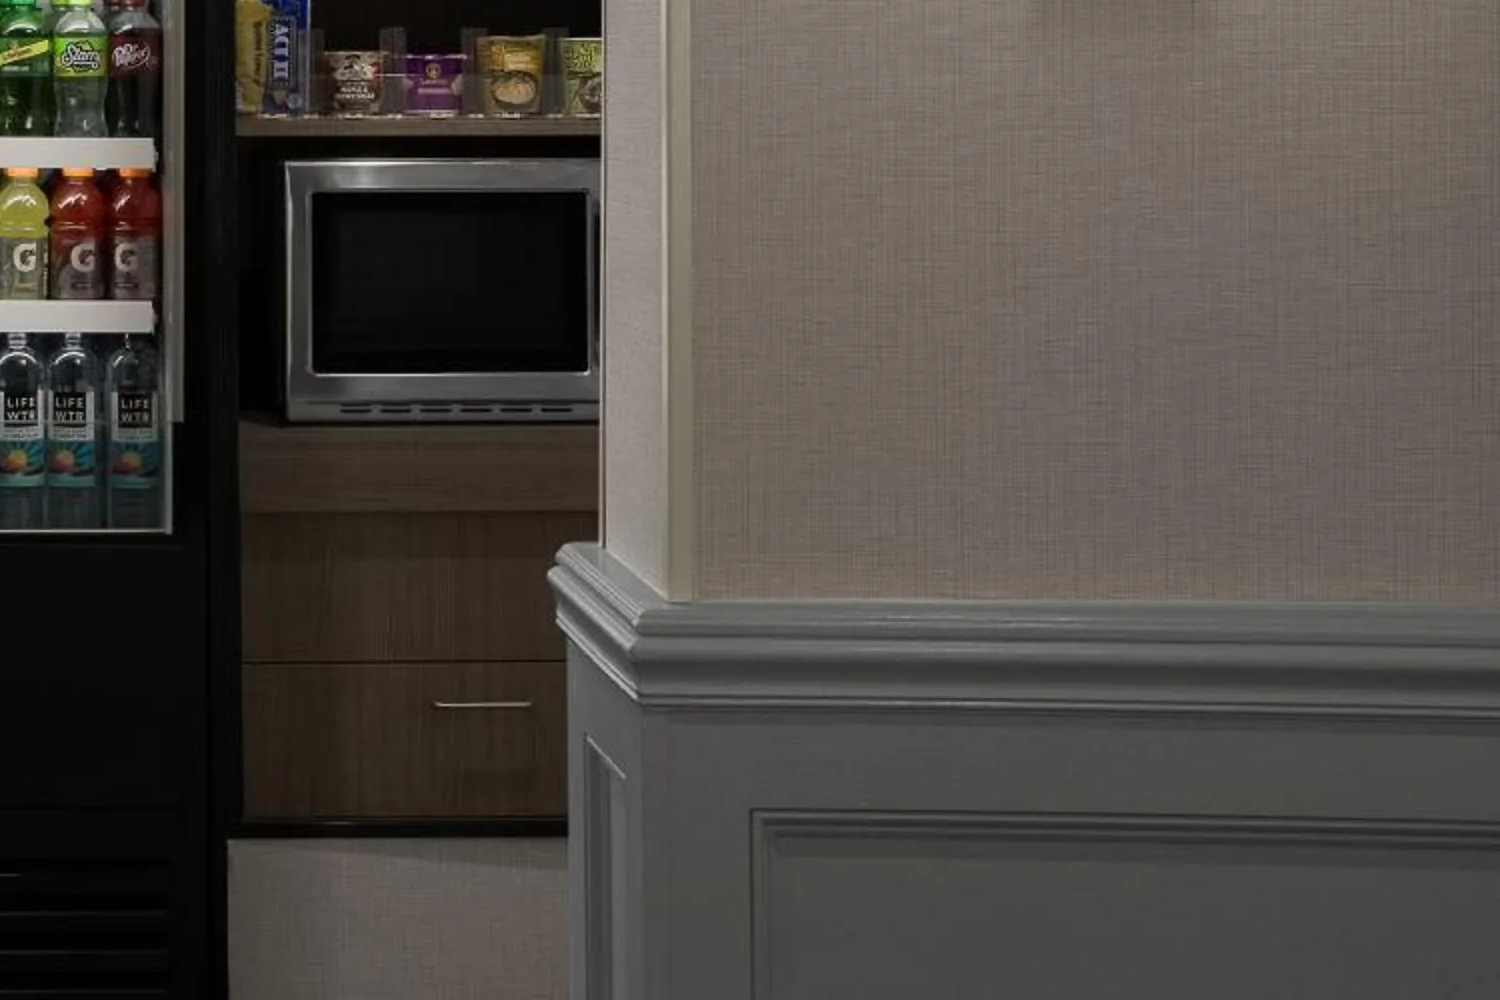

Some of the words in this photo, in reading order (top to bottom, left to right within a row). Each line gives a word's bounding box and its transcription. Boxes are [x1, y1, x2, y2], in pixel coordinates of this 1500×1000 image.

[13, 242, 37, 272] G
[71, 242, 96, 272] G
[114, 242, 138, 272] G
[7, 396, 36, 409] LIFE
[55, 396, 85, 409] LIFE
[121, 399, 149, 410] LIFE
[7, 411, 35, 421] WTR
[55, 411, 84, 421] WTR
[121, 411, 148, 423] WTR
